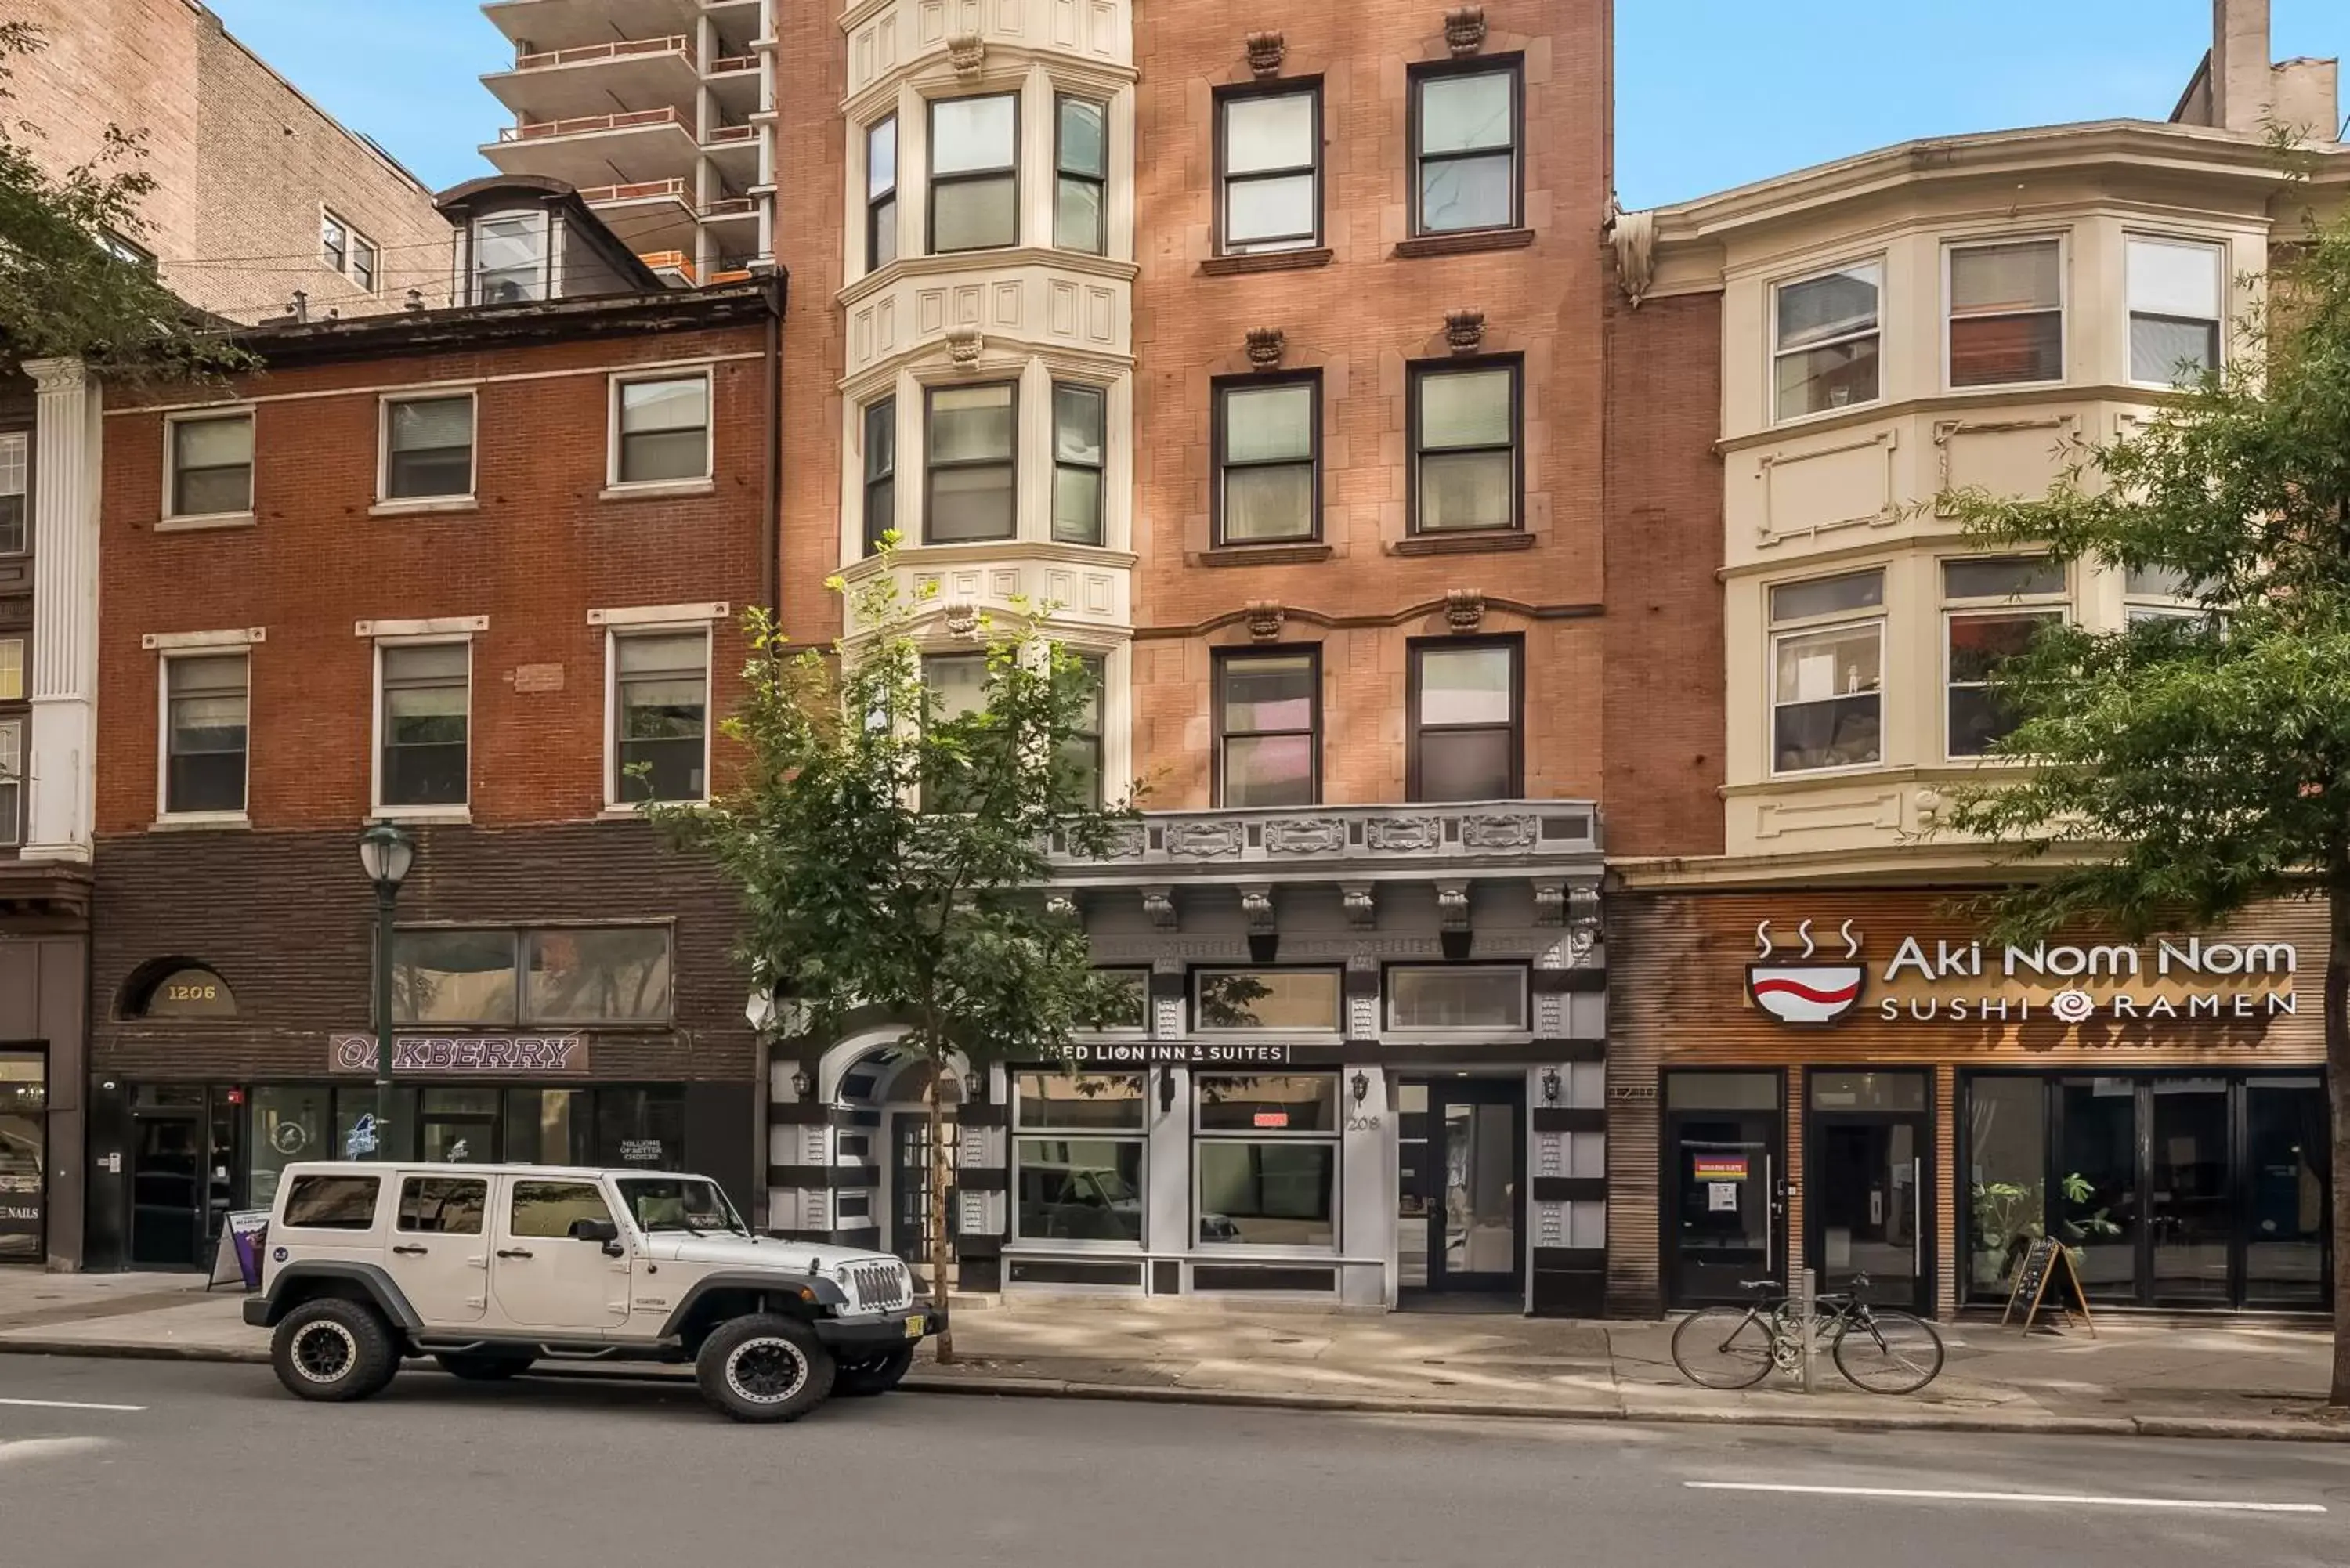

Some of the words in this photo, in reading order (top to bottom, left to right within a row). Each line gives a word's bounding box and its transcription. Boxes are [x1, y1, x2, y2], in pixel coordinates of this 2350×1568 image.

[1883, 936, 1981, 981] Aki
[2004, 939, 2138, 976] Nom
[2158, 937, 2297, 974] Nom
[168, 986, 215, 1000] 1206
[1881, 996, 2028, 1021] SUSHI
[2114, 992, 2297, 1017] RAMEN
[1097, 1046, 1145, 1060] LION
[1152, 1046, 1186, 1060] INN
[1191, 1045, 1204, 1060] &
[1209, 1046, 1282, 1060] SUITES
[9, 1207, 38, 1219] NAILS
